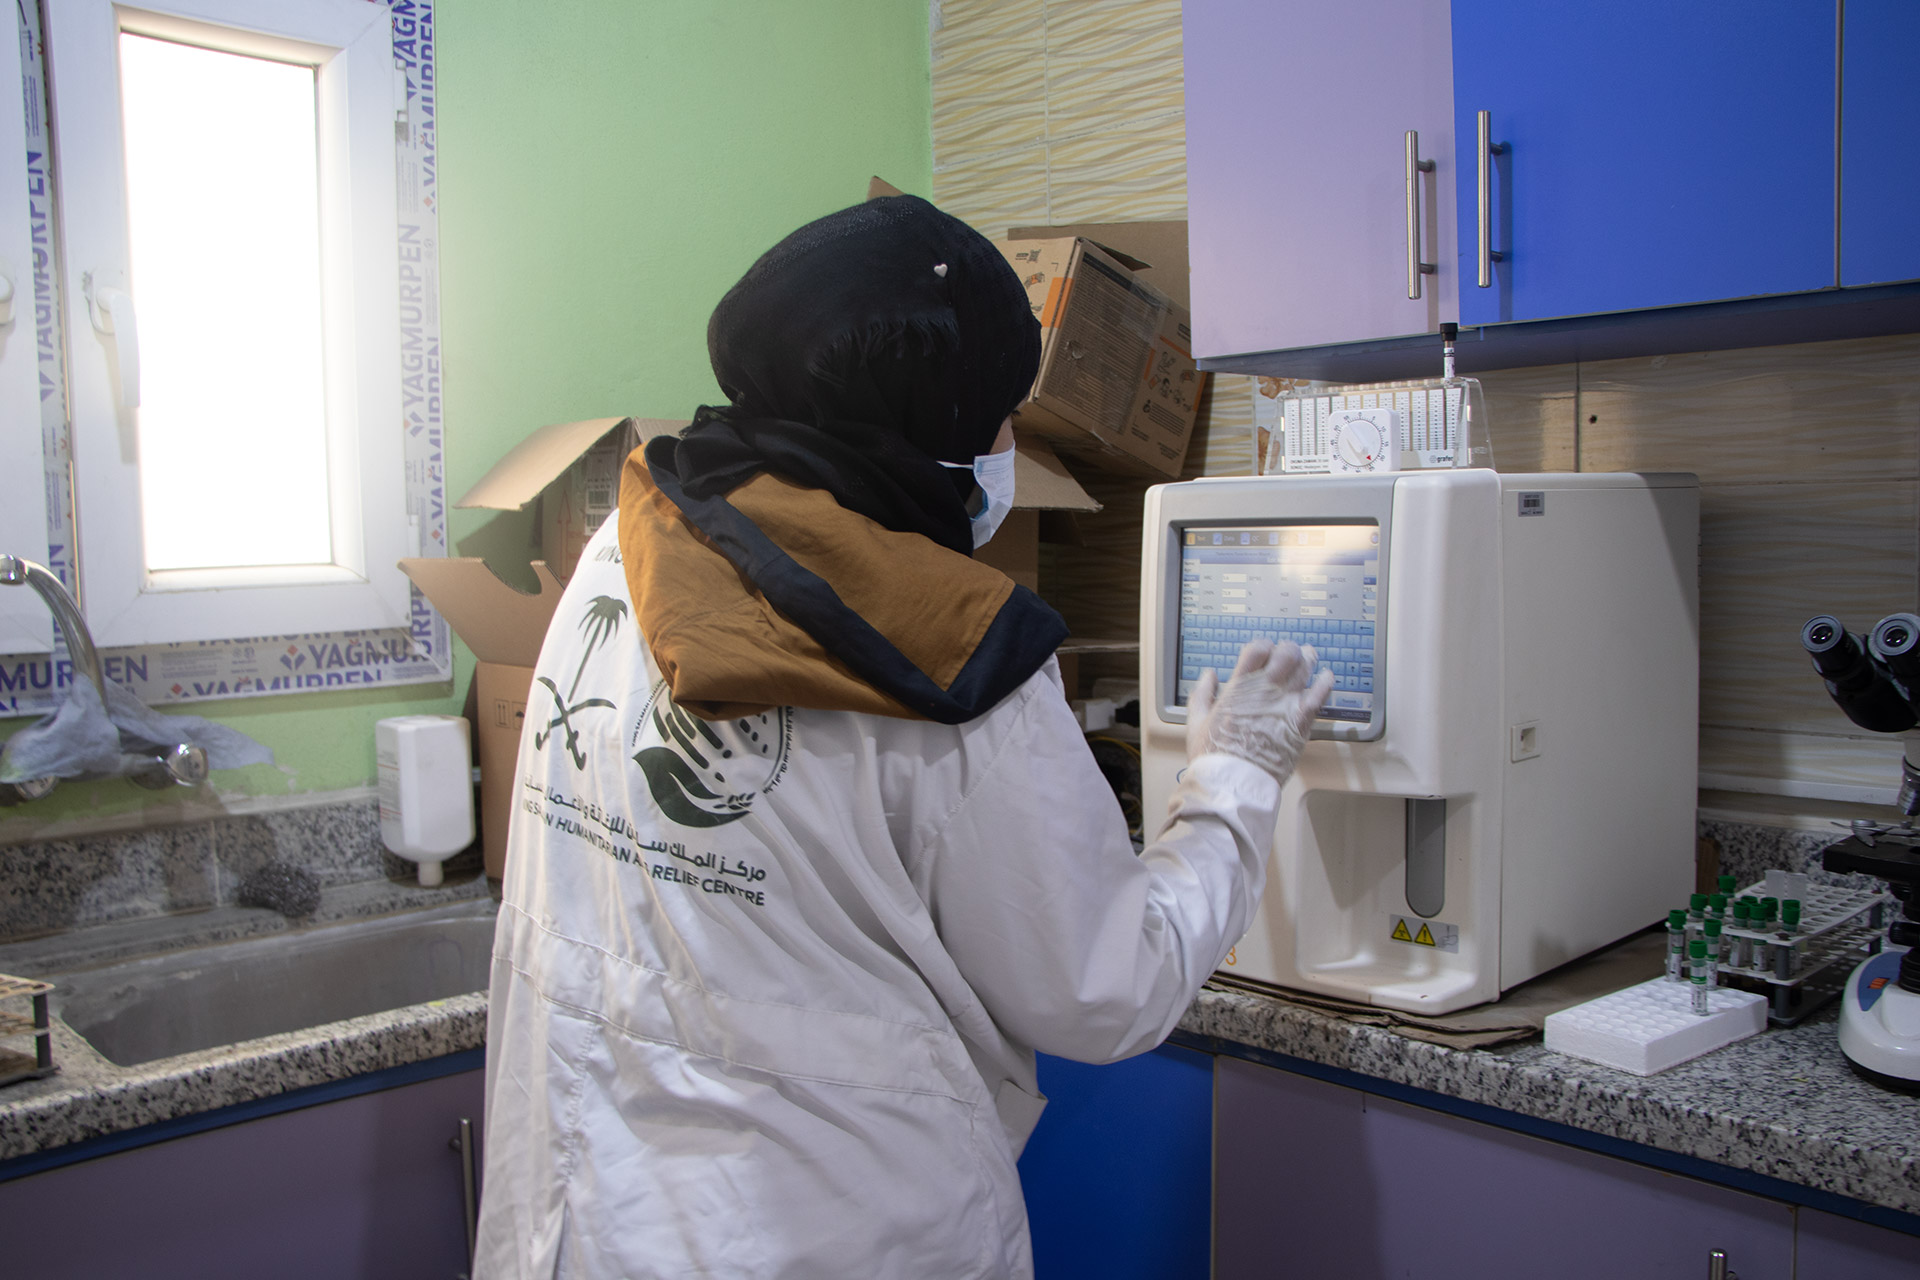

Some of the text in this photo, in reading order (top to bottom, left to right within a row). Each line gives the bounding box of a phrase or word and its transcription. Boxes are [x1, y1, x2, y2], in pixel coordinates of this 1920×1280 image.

[670, 843, 716, 868] الملك
[718, 856, 766, 882] مركز
[702, 878, 765, 907] CENTRE
